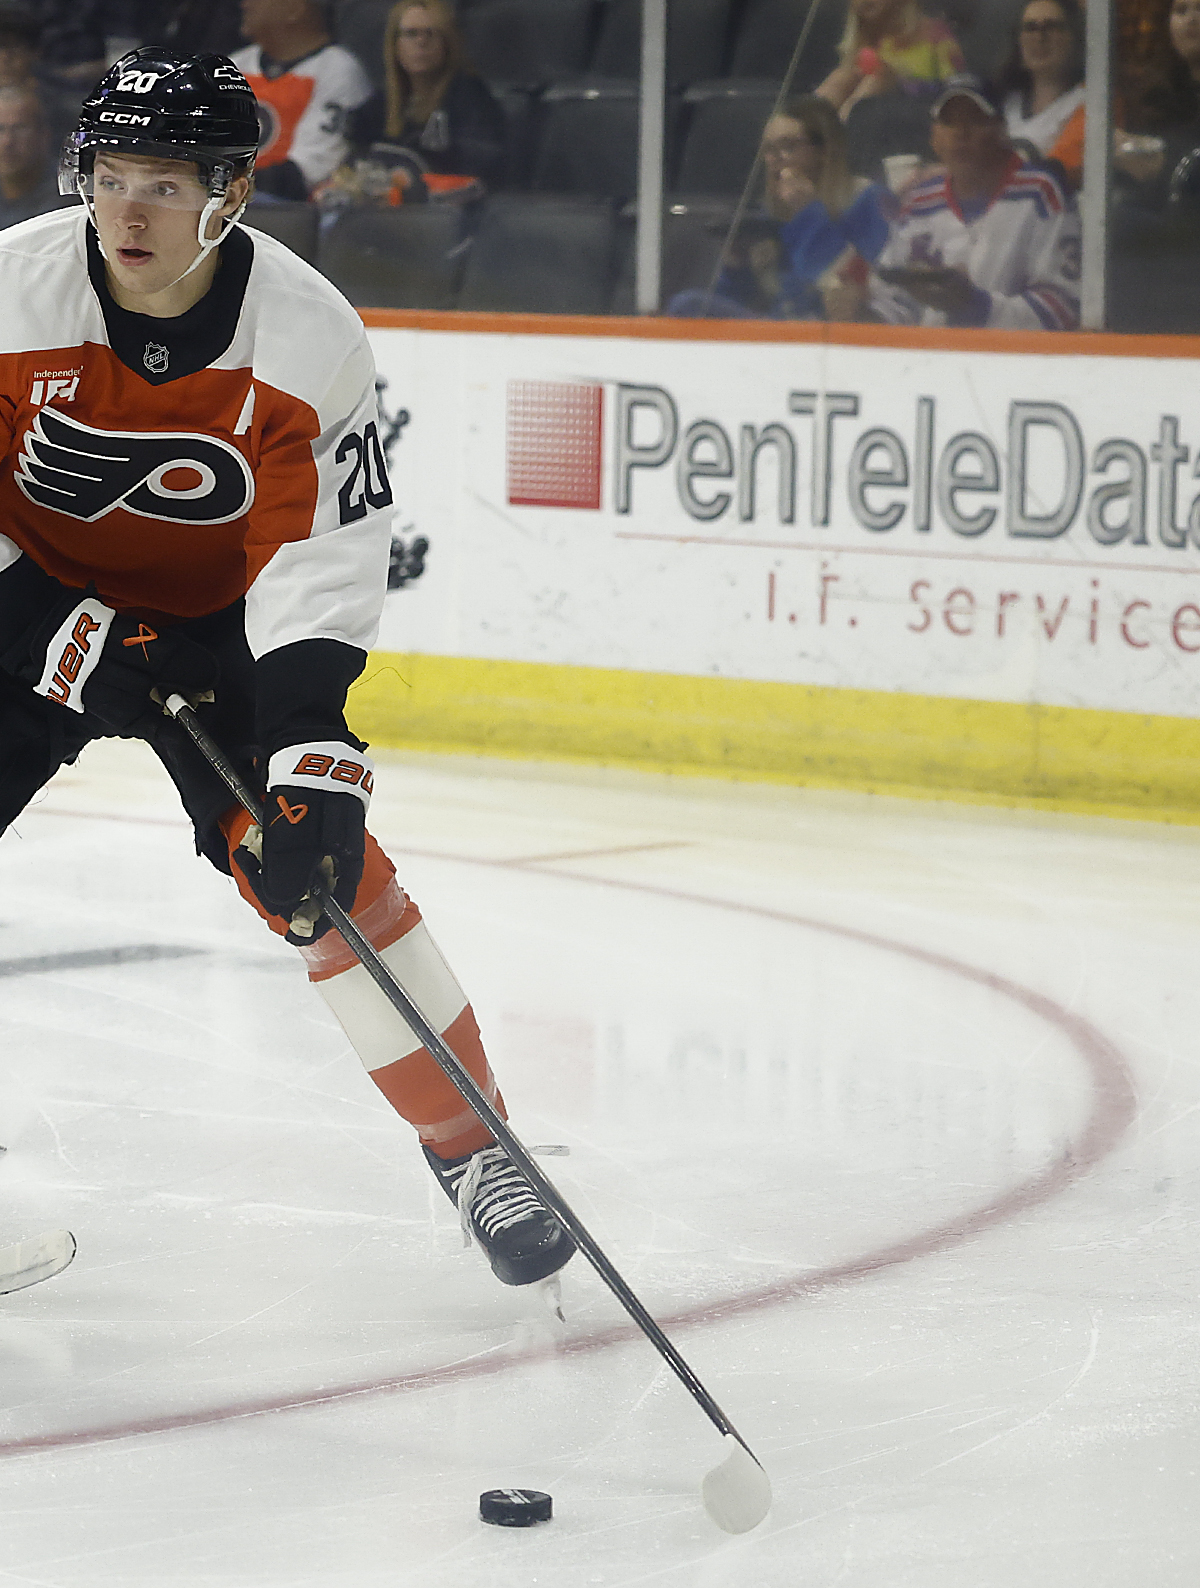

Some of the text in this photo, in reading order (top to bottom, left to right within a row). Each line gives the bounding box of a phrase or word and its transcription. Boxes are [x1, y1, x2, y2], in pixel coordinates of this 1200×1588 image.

[116, 70, 158, 94] 20
[99, 111, 151, 127] CCM
[335, 420, 394, 526] 20
[46, 611, 101, 706] UER
